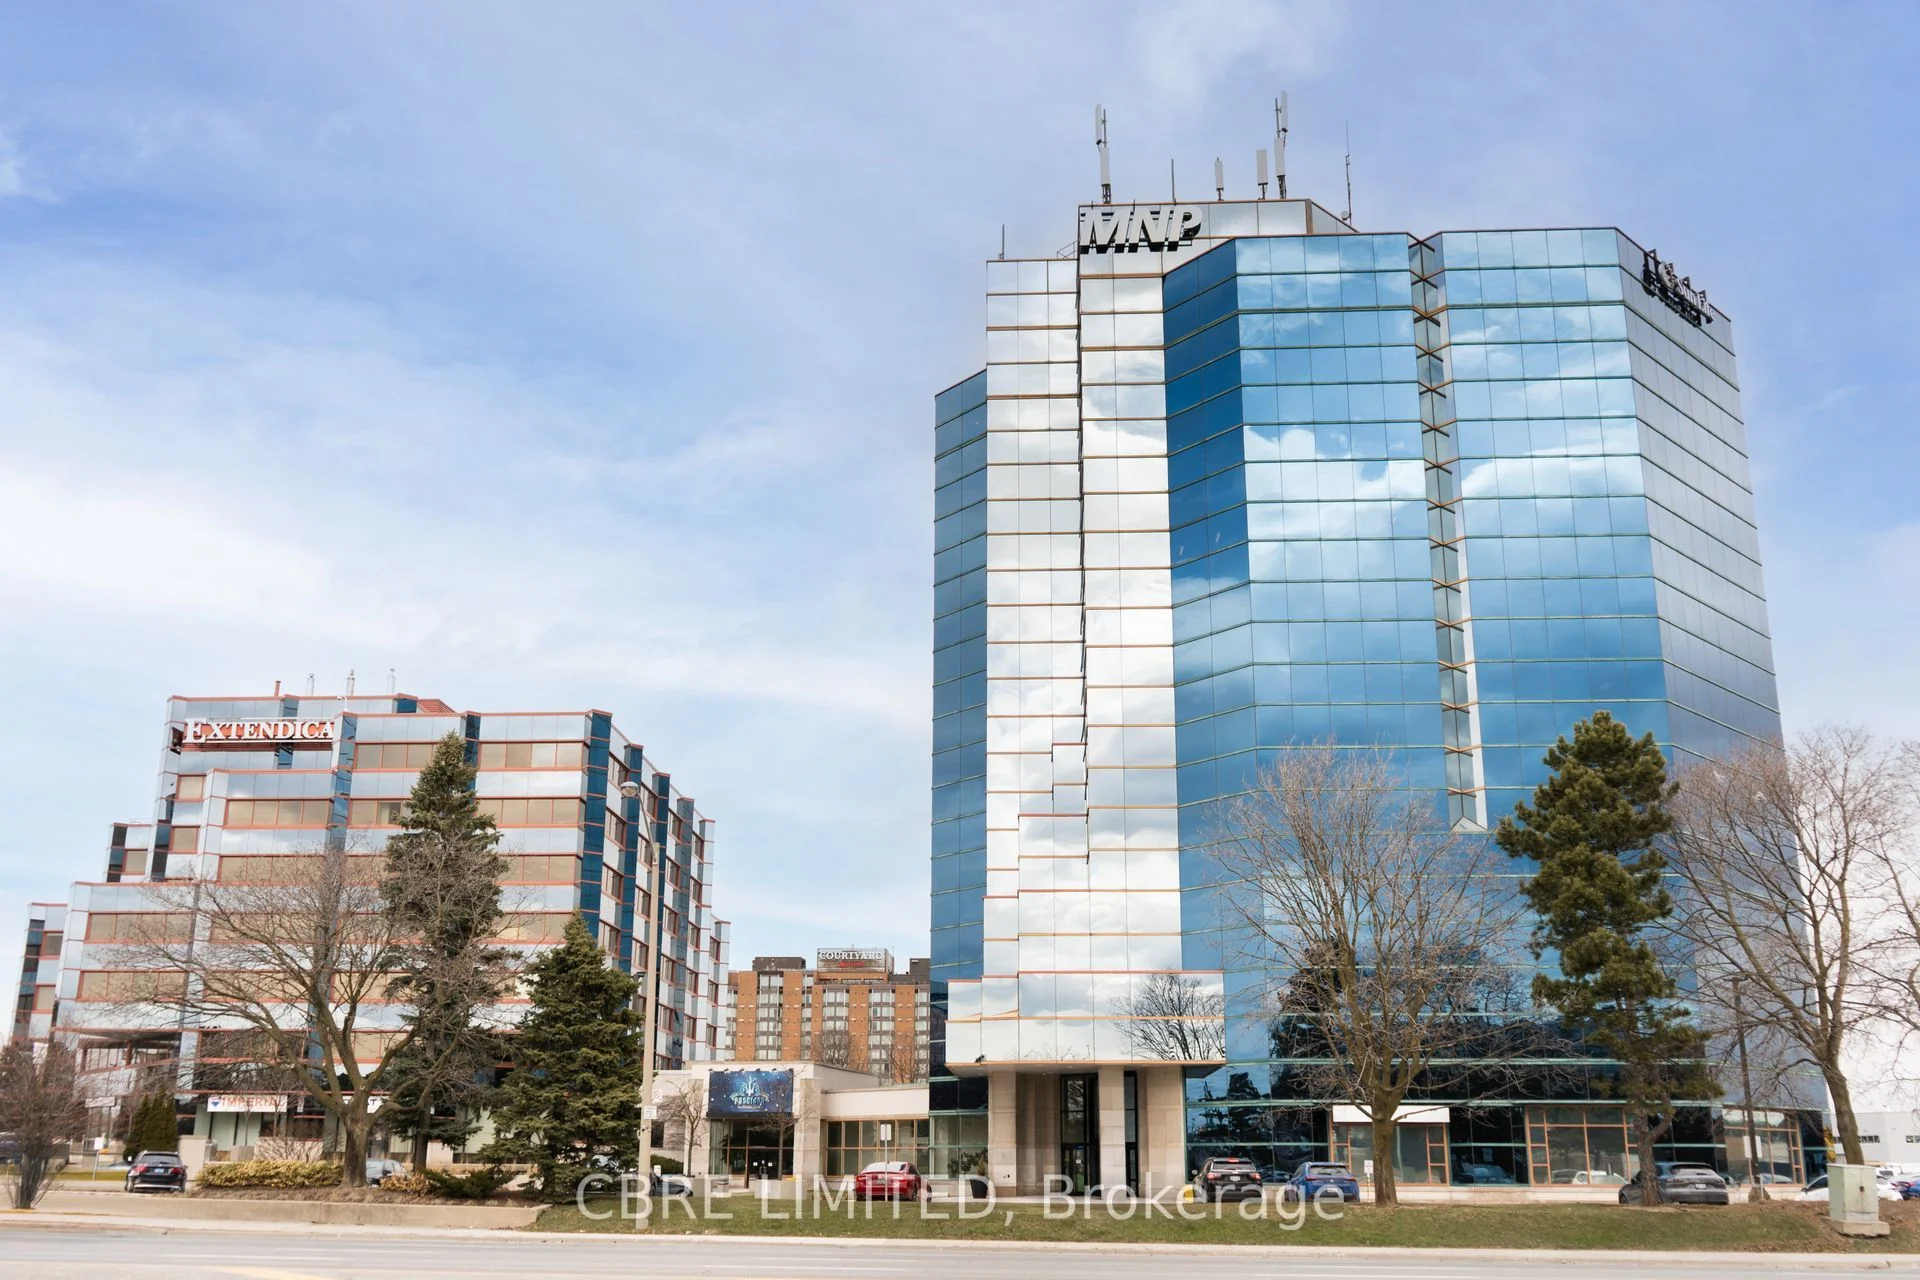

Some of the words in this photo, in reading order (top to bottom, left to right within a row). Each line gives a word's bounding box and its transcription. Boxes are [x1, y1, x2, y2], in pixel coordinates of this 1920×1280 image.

[1080, 204, 1203, 246] MNP
[183, 718, 335, 743] EXTENDICA
[819, 951, 883, 960] COURTYARD
